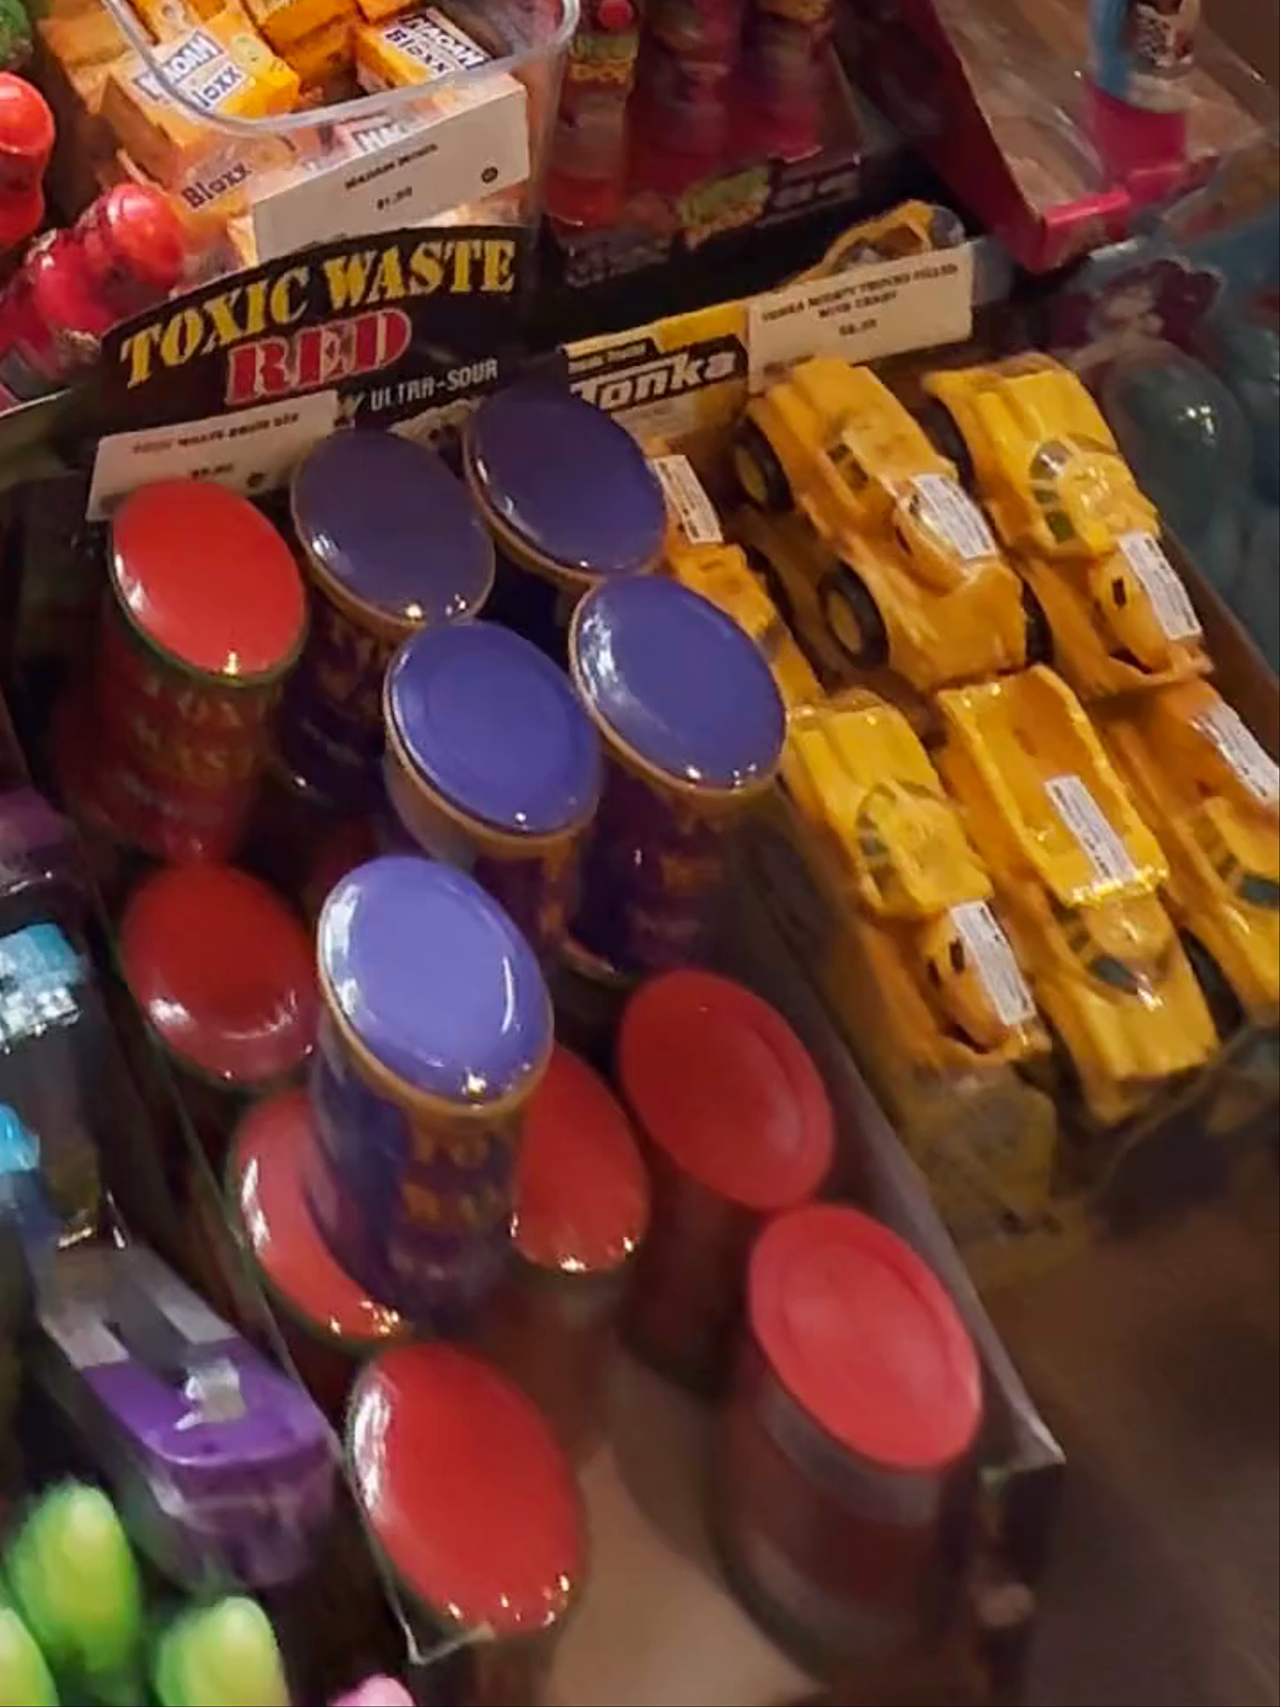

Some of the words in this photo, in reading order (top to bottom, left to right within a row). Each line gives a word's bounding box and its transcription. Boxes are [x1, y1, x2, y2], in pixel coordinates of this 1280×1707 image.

[180, 162, 254, 210] Bloxx
[120, 264, 313, 389] TOXIC
[324, 238, 517, 311] WASTE
[225, 306, 413, 406] RED
[370, 357, 499, 413] ULTRA-SOUR
[569, 350, 737, 412] Tonka
